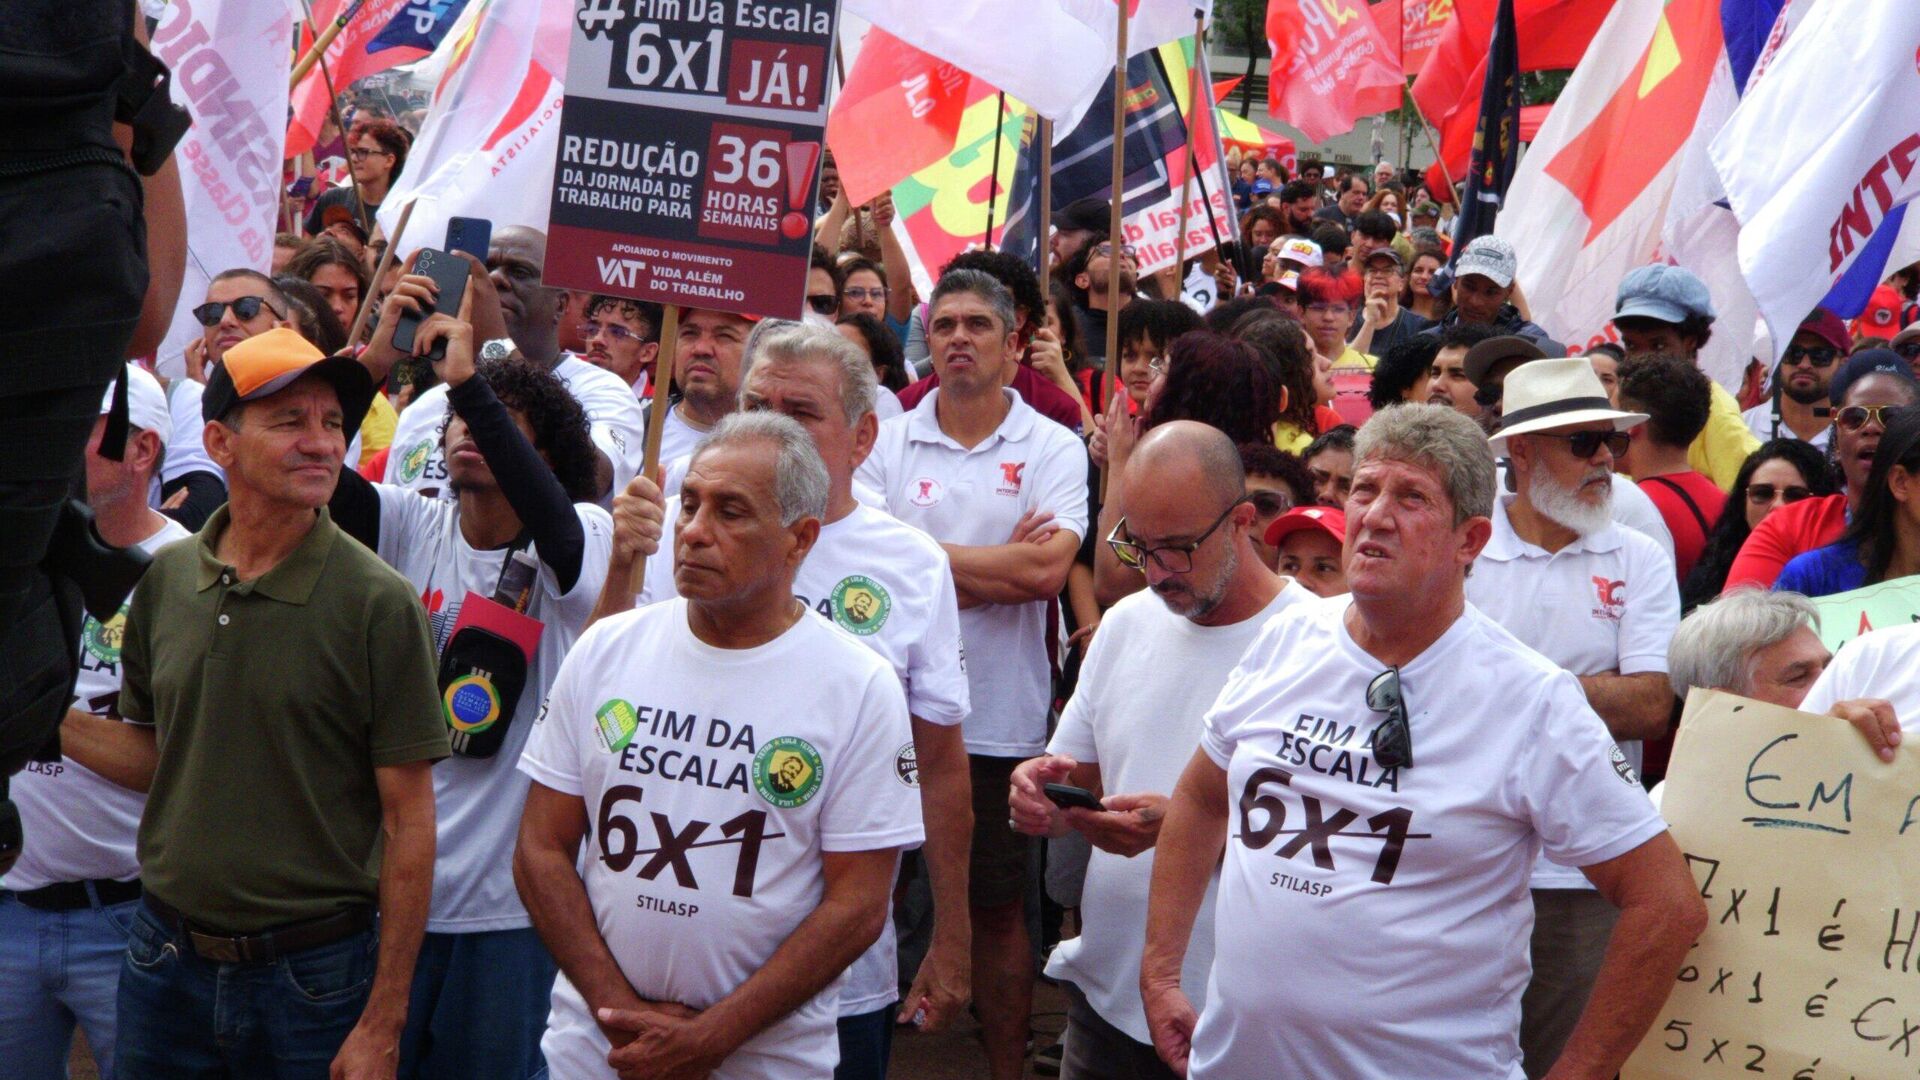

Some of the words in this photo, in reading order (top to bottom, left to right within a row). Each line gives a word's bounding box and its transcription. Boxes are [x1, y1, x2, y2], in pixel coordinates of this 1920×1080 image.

[633, 0, 679, 21] Fim
[687, 0, 724, 24] Da
[735, 1, 830, 35] Escala
[625, 23, 724, 93] 6x1
[738, 49, 809, 107] JÁ!
[562, 134, 700, 178] REDUÇÃO
[713, 135, 781, 189] 36
[562, 168, 585, 187] DA
[587, 171, 667, 197] JORNADA
[669, 180, 693, 200] DE
[558, 187, 644, 213] TRABALHO
[648, 198, 693, 220] PARA
[706, 190, 779, 215] HORAS
[702, 210, 779, 231] SEMANAIS
[611, 243, 661, 258] APOIANDO
[662, 250, 670, 259] O
[671, 252, 733, 267] MOVIMENTO
[596, 256, 646, 289] VAT
[652, 265, 683, 280] VIDA
[685, 269, 724, 285] ALÉM
[650, 279, 670, 292] DO
[672, 282, 746, 302] TRABALHO
[423, 460, 449, 480] ES
[637, 706, 695, 743] FIM
[707, 718, 755, 754] DA
[1294, 714, 1357, 746] FIM
[24, 761, 64, 777] LASP
[619, 743, 750, 793] ESCALA
[901, 761, 917, 770] STIL
[1276, 731, 1398, 792] ESCALA
[599, 785, 767, 898] 6x1
[1239, 767, 1414, 885] 6x1
[1270, 871, 1333, 899] STILASP
[636, 895, 699, 917] STILASP
[1884, 908, 1920, 972] H
